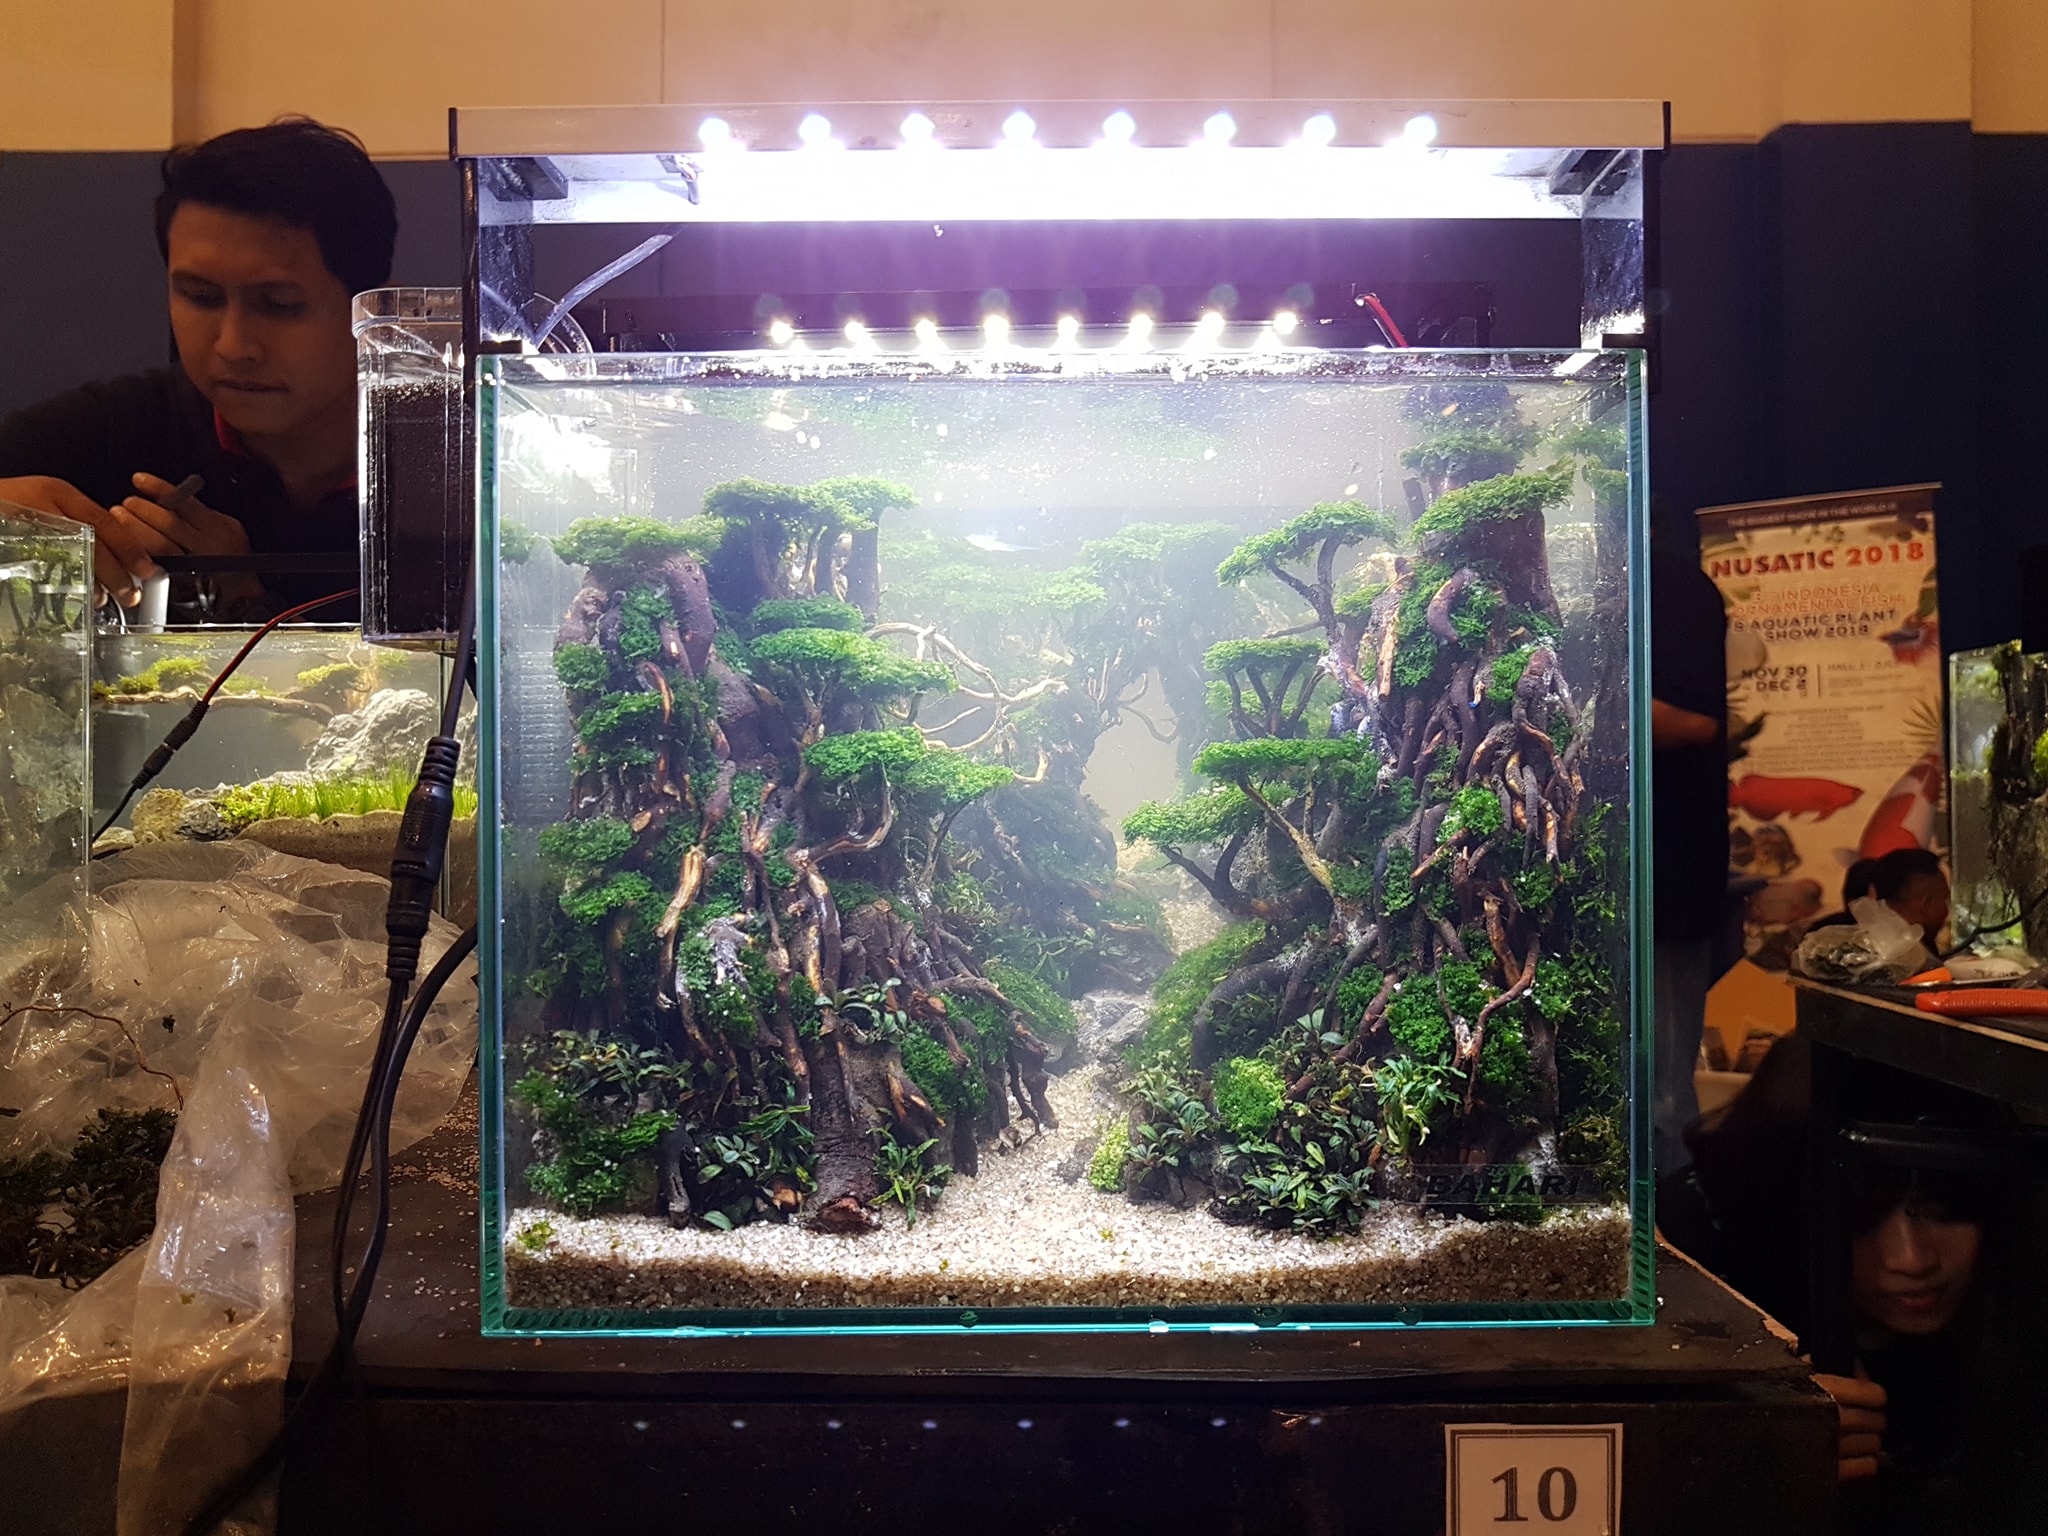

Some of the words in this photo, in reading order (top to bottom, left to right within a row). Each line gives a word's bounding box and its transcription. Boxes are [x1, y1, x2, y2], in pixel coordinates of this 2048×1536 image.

[1711, 550, 1835, 579] NUSATIC
[1846, 542, 1924, 568] 2018
[1781, 583, 1881, 600] INDONESIA
[1732, 597, 1857, 619] ORNAMENTAL
[1750, 614, 1831, 631] AQUATIC
[1835, 609, 1896, 625] PLANT
[1764, 627, 1820, 642] SHOW
[1825, 624, 1870, 639] 2018
[1741, 667, 1780, 680] NOV
[1785, 665, 1808, 679] 30
[1756, 679, 1791, 692] DEC
[1427, 1174, 1582, 1195] BAHARI
[1491, 1466, 1577, 1522] 10
